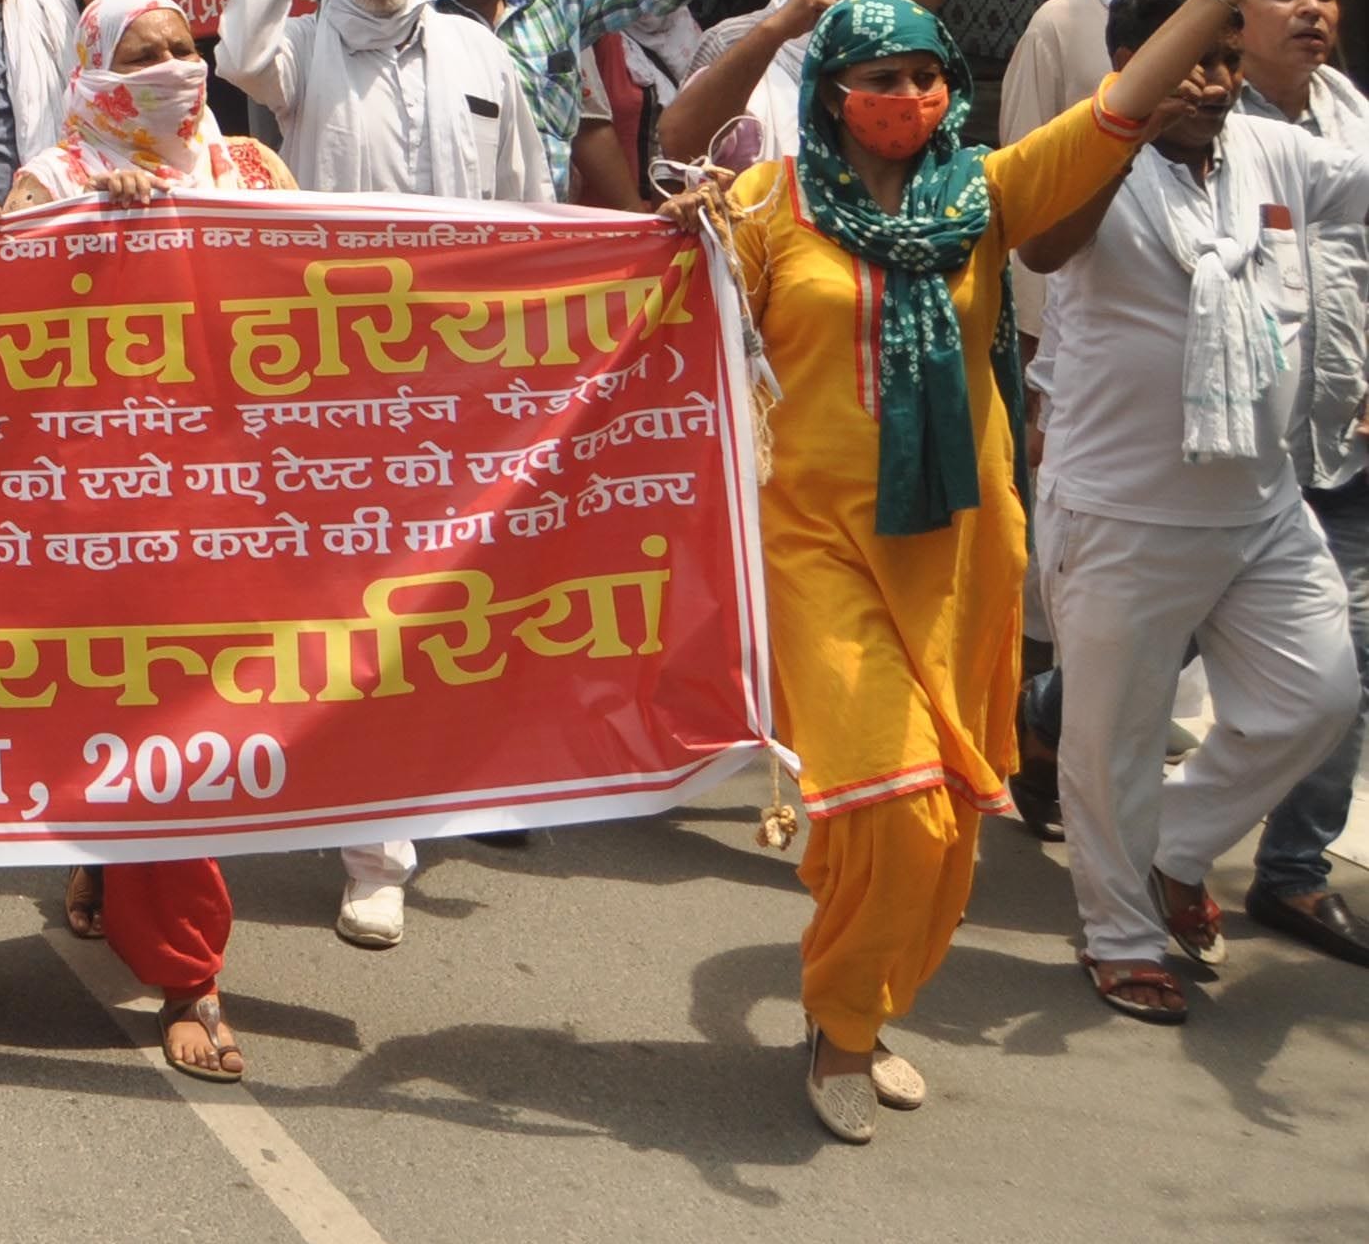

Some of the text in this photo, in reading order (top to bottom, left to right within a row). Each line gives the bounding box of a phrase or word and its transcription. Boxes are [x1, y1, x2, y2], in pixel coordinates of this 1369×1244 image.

[65, 232, 118, 261] प्रथा
[124, 227, 194, 253] खत्म
[201, 226, 252, 249] कर
[259, 223, 329, 250] कच्चे
[337, 221, 495, 252] कर्मचारियों
[220, 249, 696, 397] हरियाणा
[0, 456, 66, 503] को
[77, 452, 172, 498] रखे
[183, 461, 267, 505] गए
[272, 447, 373, 493] टेस्ट
[383, 439, 453, 488] को
[571, 391, 719, 462] करवाने
[30, 396, 213, 438] गवर्नमेंट
[44, 529, 180, 571] बहाल
[191, 511, 310, 562] करने
[320, 505, 391, 556] की
[403, 506, 496, 552] मांग
[504, 490, 567, 538] को
[576, 471, 696, 519] लेकर
[83, 731, 288, 804] 2020
